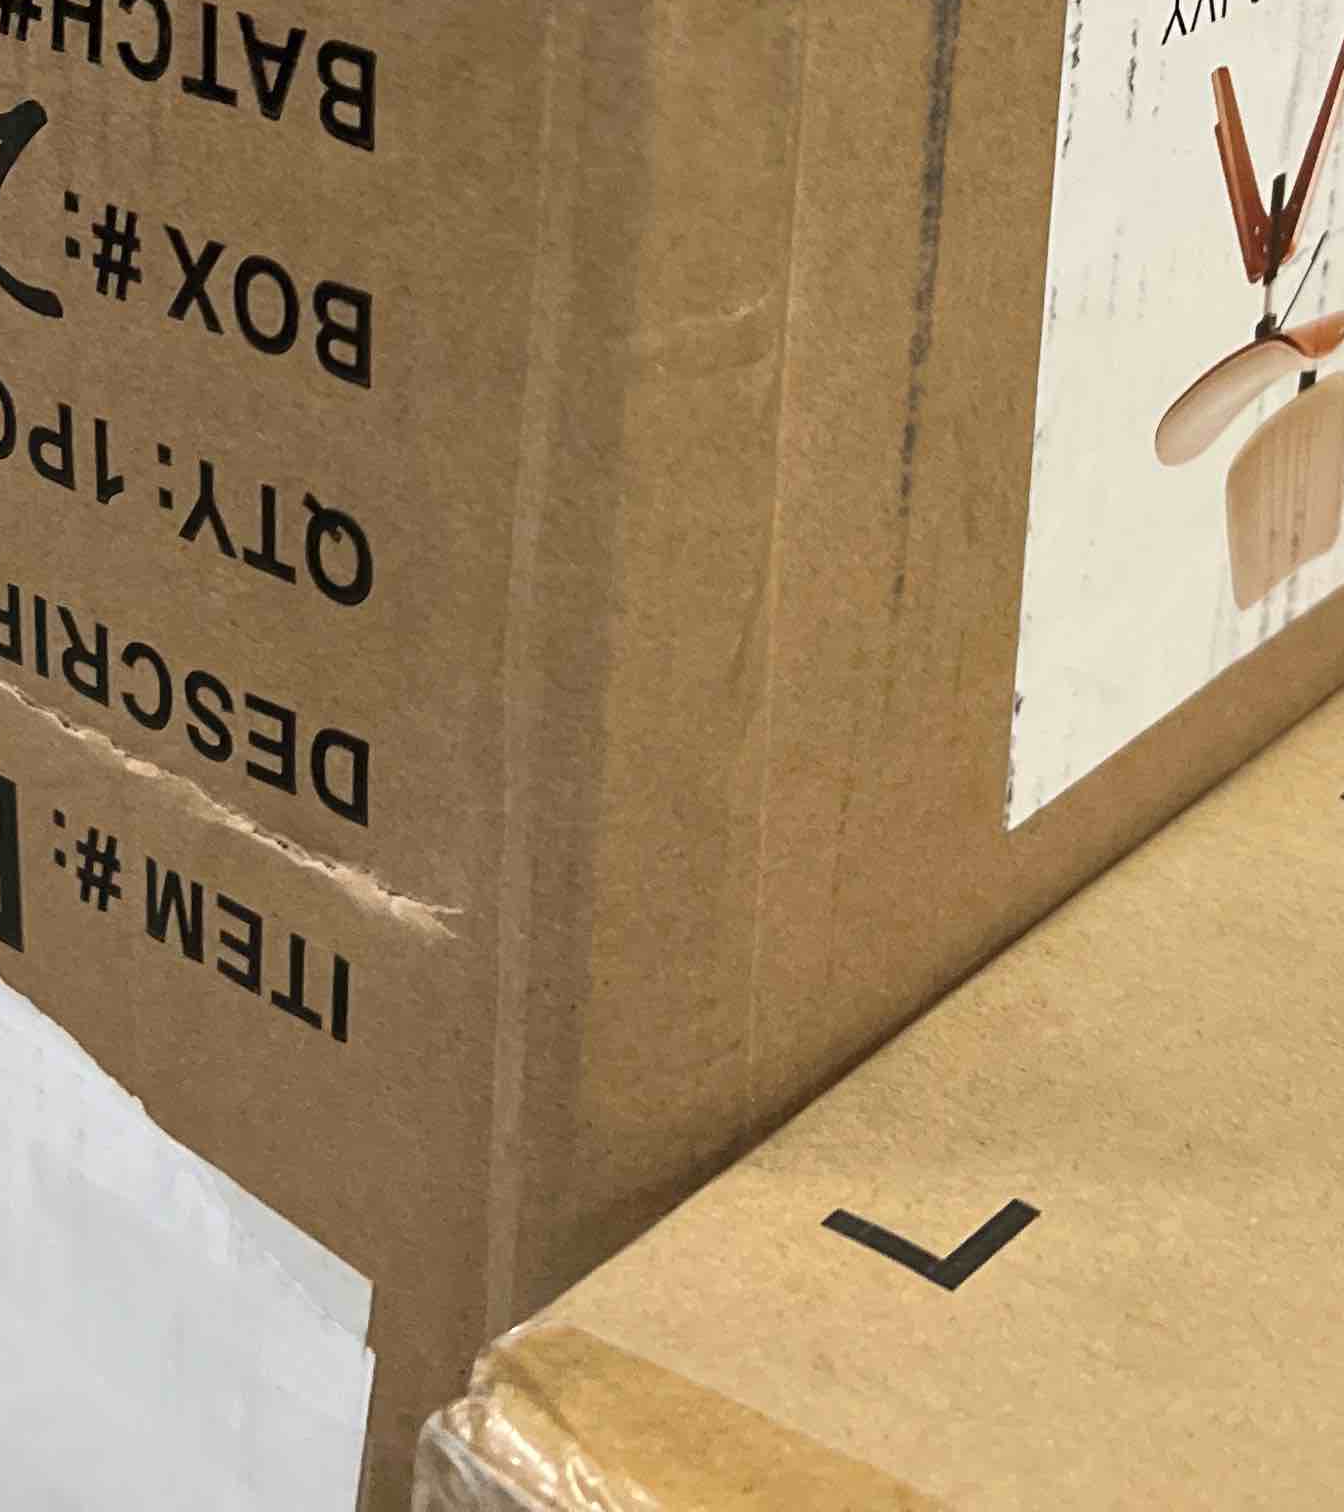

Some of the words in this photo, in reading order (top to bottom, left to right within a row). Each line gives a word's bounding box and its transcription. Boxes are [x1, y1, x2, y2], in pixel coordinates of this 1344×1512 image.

[63, 191, 143, 302] #:
[164, 224, 373, 390] BOX
[156, 443, 374, 608] QTY:
[52, 810, 122, 913] #:
[145, 856, 351, 1044] ITEM
